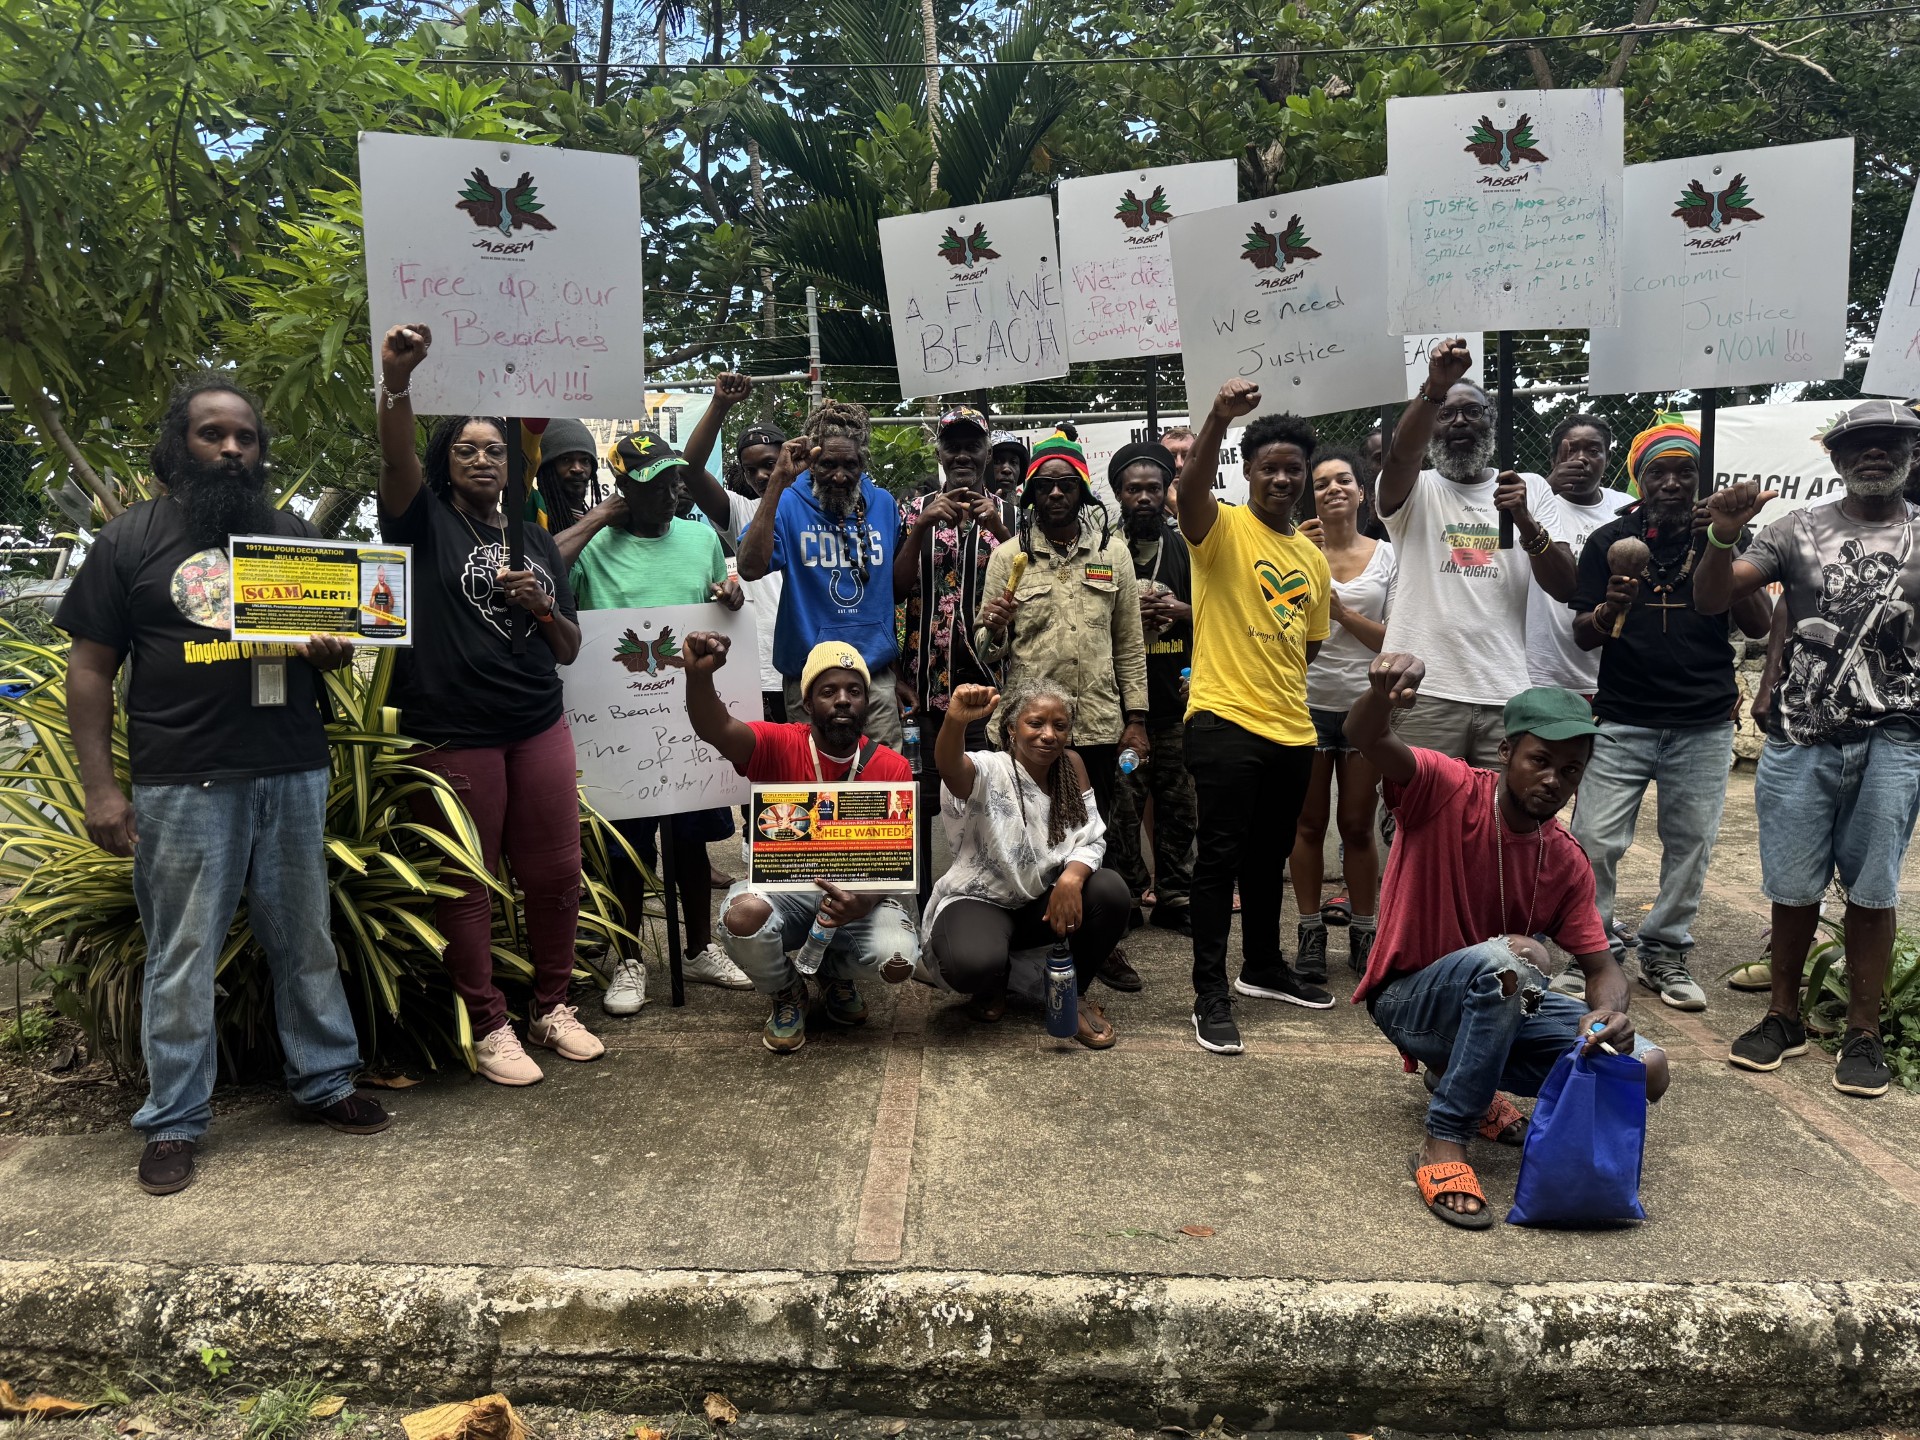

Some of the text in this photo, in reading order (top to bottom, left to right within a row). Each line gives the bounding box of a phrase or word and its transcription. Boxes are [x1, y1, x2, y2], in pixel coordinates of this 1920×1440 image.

[1476, 172, 1529, 187] JABBEM
[1478, 219, 1509, 233] one
[1522, 214, 1551, 233] big
[1562, 208, 1597, 225] and
[472, 239, 534, 255] JABBEM
[1124, 231, 1164, 245] JABBEM
[1684, 231, 1742, 249] JABBEM
[950, 267, 988, 282] JABBEM
[1072, 266, 1112, 294] We
[1255, 269, 1305, 288] JABBEM
[1427, 271, 1454, 286] one
[1535, 257, 1577, 271] Love
[1622, 264, 1741, 292] conomic
[398, 263, 477, 299] Free
[499, 276, 536, 315] up
[905, 298, 924, 320] A
[1007, 273, 1060, 311] WE
[1090, 294, 1158, 320] People
[1212, 286, 1345, 336] We need
[1682, 296, 1796, 331] Justice
[442, 309, 609, 352] Beaches
[921, 318, 1060, 373] BEACH
[1236, 341, 1346, 377] Justice
[1086, 451, 1113, 460] LITY
[1805, 477, 1845, 500] AC
[1457, 522, 1490, 535] BEACH
[263, 545, 295, 553] BALFOUR
[296, 547, 344, 556] DECLARATION
[800, 531, 884, 568] COLTS
[1472, 536, 1499, 550] RIGH
[1463, 565, 1499, 579] RIGHTS
[246, 585, 351, 601] SCAM ALERT!
[184, 639, 240, 664] Kingdom
[626, 677, 675, 692] JABBEM
[608, 704, 671, 720] Beach
[651, 726, 704, 748] Peop
[824, 827, 906, 838] HELP WANTED!
